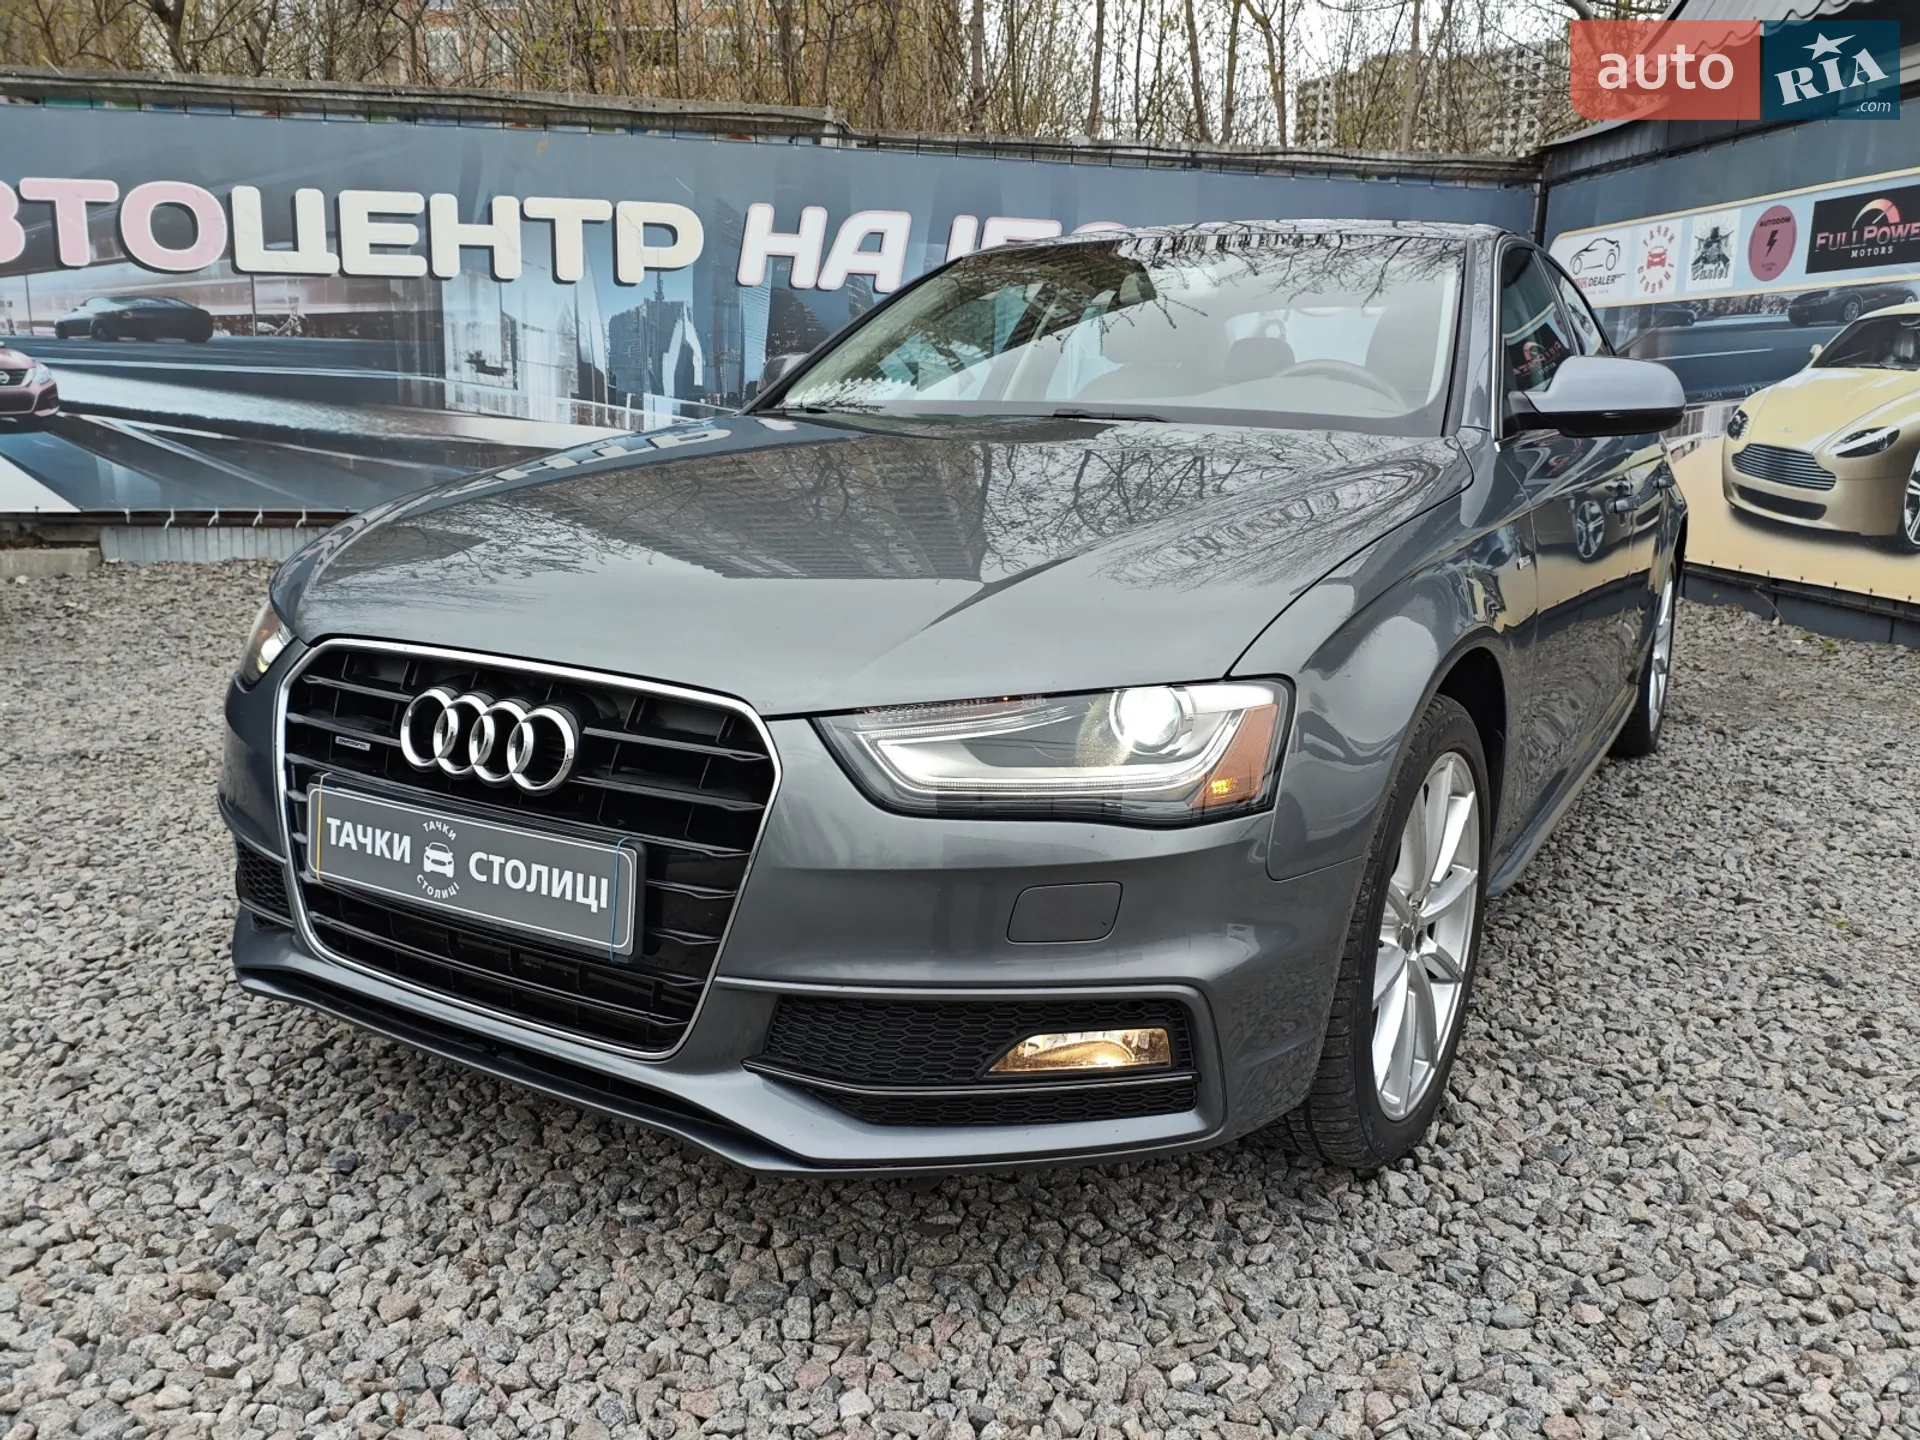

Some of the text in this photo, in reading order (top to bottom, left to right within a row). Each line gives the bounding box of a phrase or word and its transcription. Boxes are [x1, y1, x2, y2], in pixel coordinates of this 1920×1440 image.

[1759, 216, 1792, 228] AUTODOM
[737, 202, 912, 294] НА
[1814, 230, 1861, 253] FULL
[1850, 245, 1894, 258] MOTORS
[422, 820, 457, 842] ТАЧКИ
[326, 817, 609, 914] ТАЧКИ СТОЛИЦІ
[416, 874, 460, 899] СТОЛИЦІ
